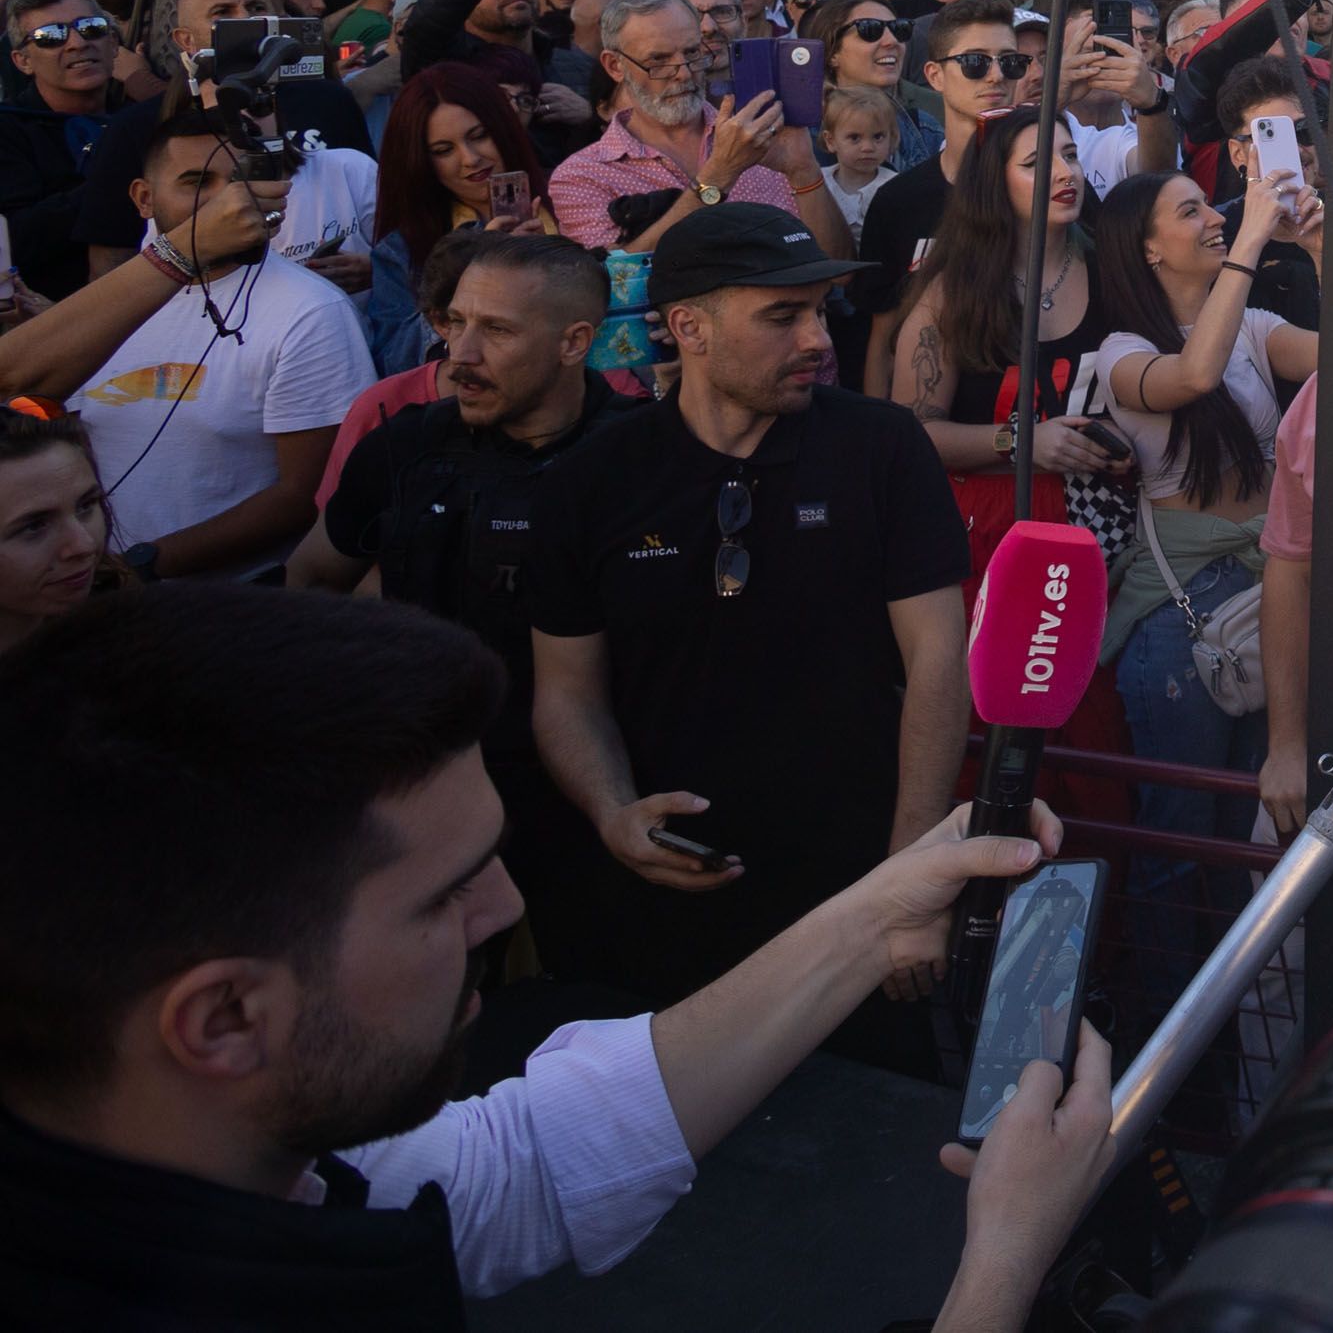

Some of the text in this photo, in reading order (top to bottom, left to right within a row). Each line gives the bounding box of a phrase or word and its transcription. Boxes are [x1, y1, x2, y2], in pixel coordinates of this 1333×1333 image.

[799, 508, 825, 516] POLO
[628, 547, 679, 559] VERTICAL
[1020, 562, 1070, 695] 101tv.es
